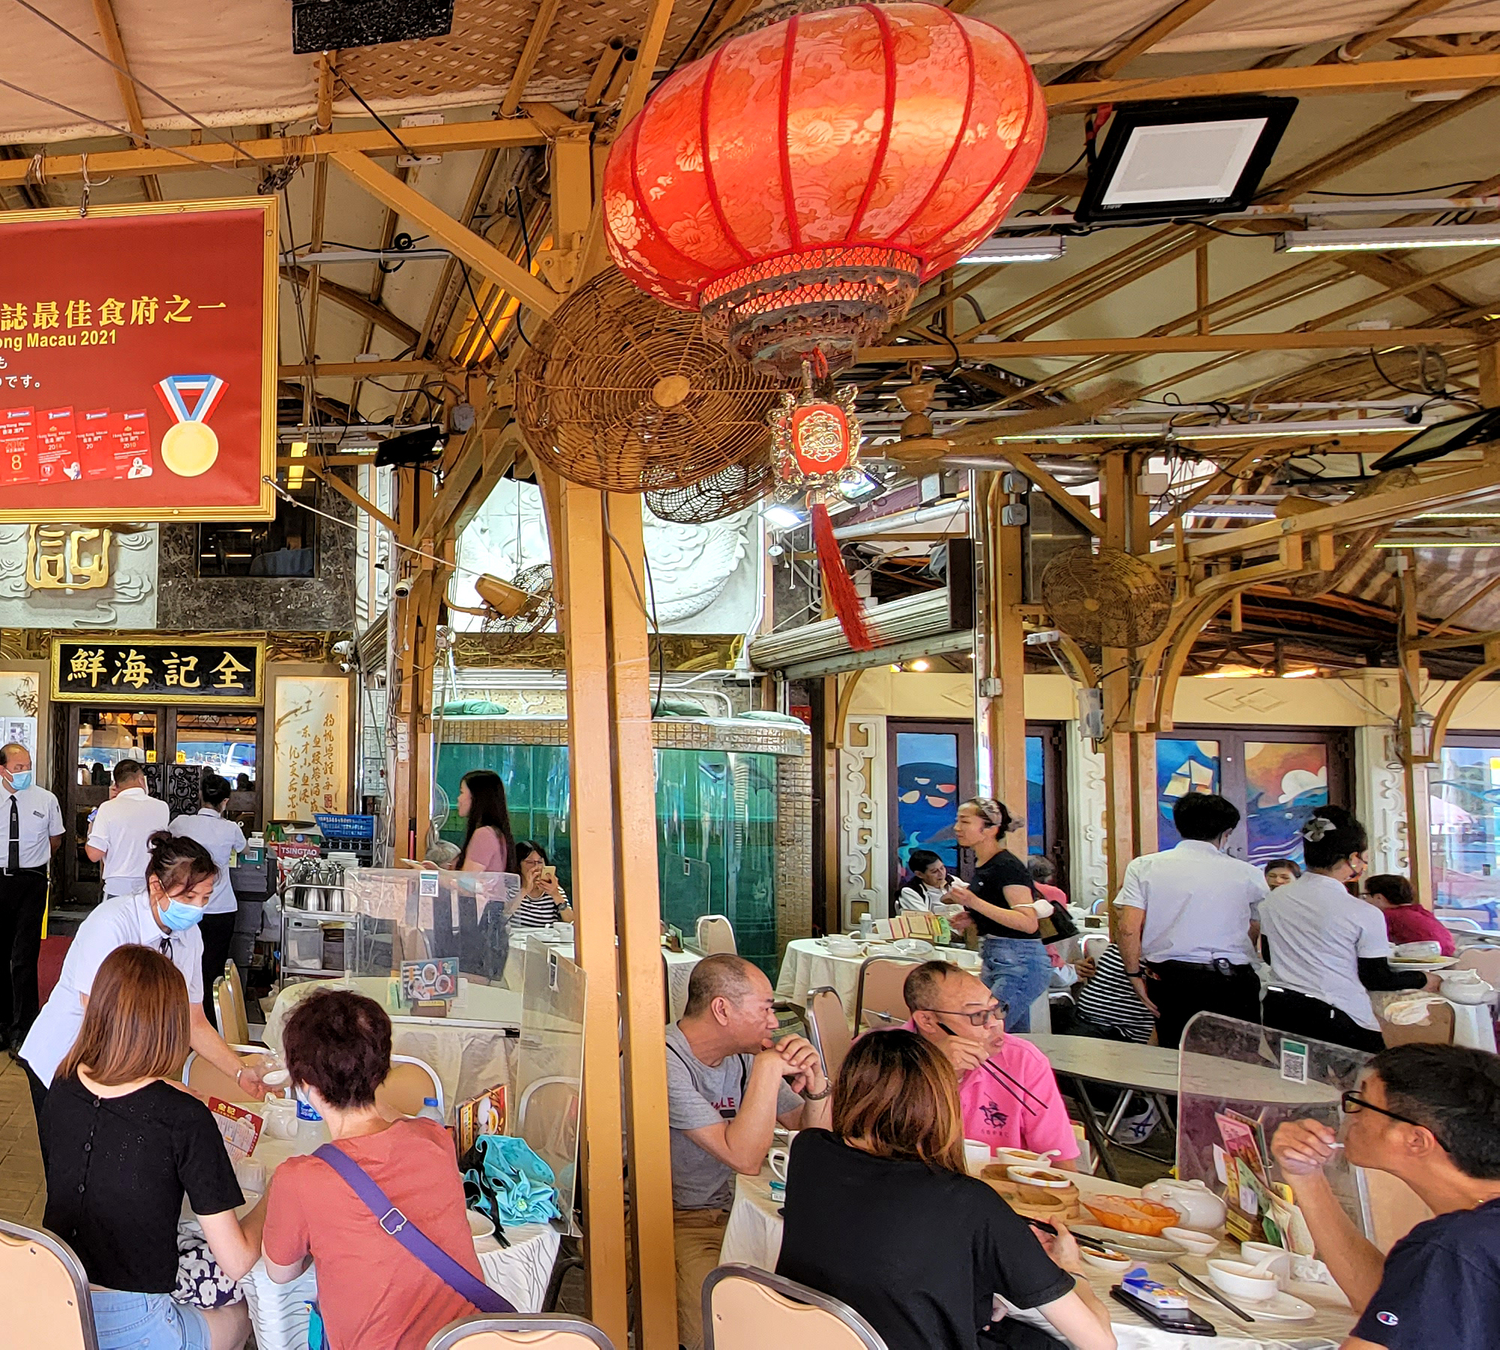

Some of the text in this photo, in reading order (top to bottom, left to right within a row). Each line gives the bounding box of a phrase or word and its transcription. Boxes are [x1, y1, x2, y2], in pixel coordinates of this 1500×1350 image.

[27, 330, 77, 348] Macau
[80, 329, 116, 346] 2021
[11, 454, 22, 471] 8
[281, 847, 317, 856] TSINGTAO
